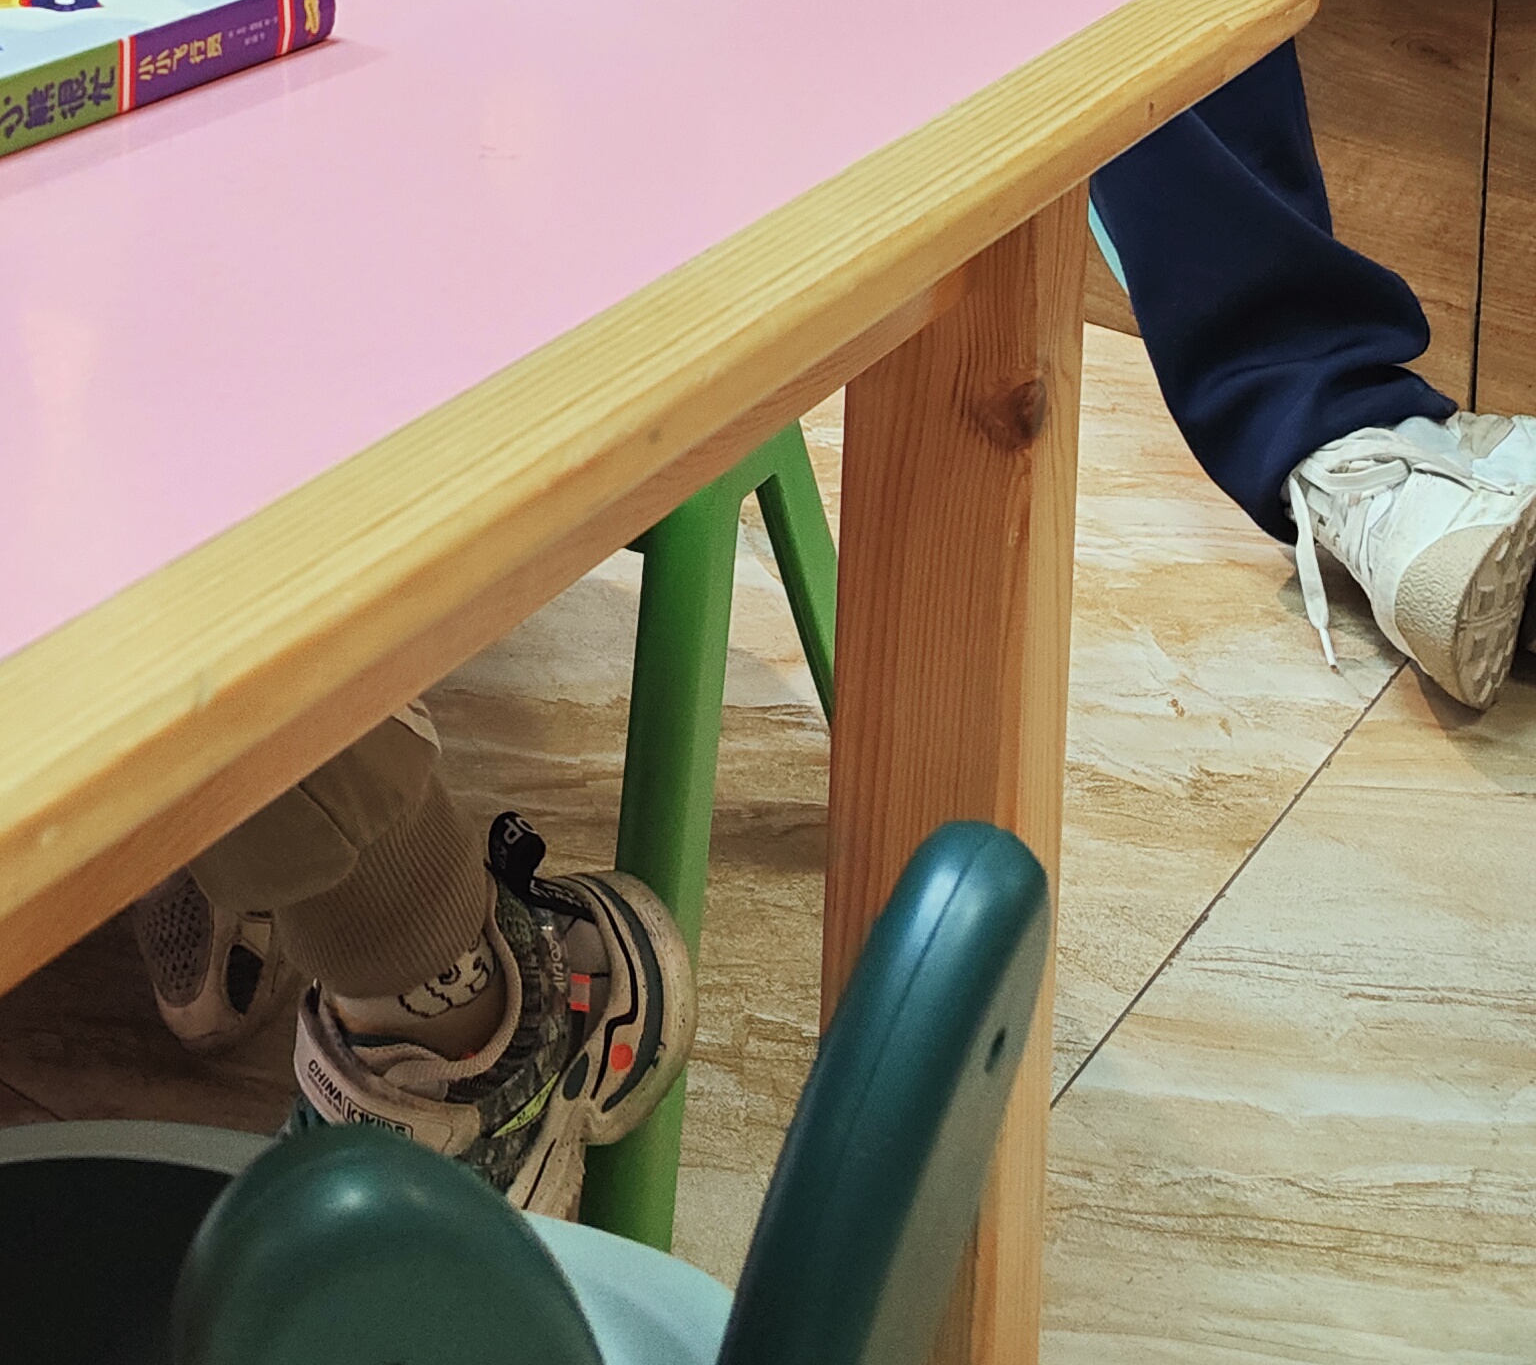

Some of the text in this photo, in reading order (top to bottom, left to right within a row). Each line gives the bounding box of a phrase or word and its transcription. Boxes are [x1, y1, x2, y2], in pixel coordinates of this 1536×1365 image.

[137, 29, 224, 82] 小小飞行员
[307, 1058, 343, 1107] CHINA
